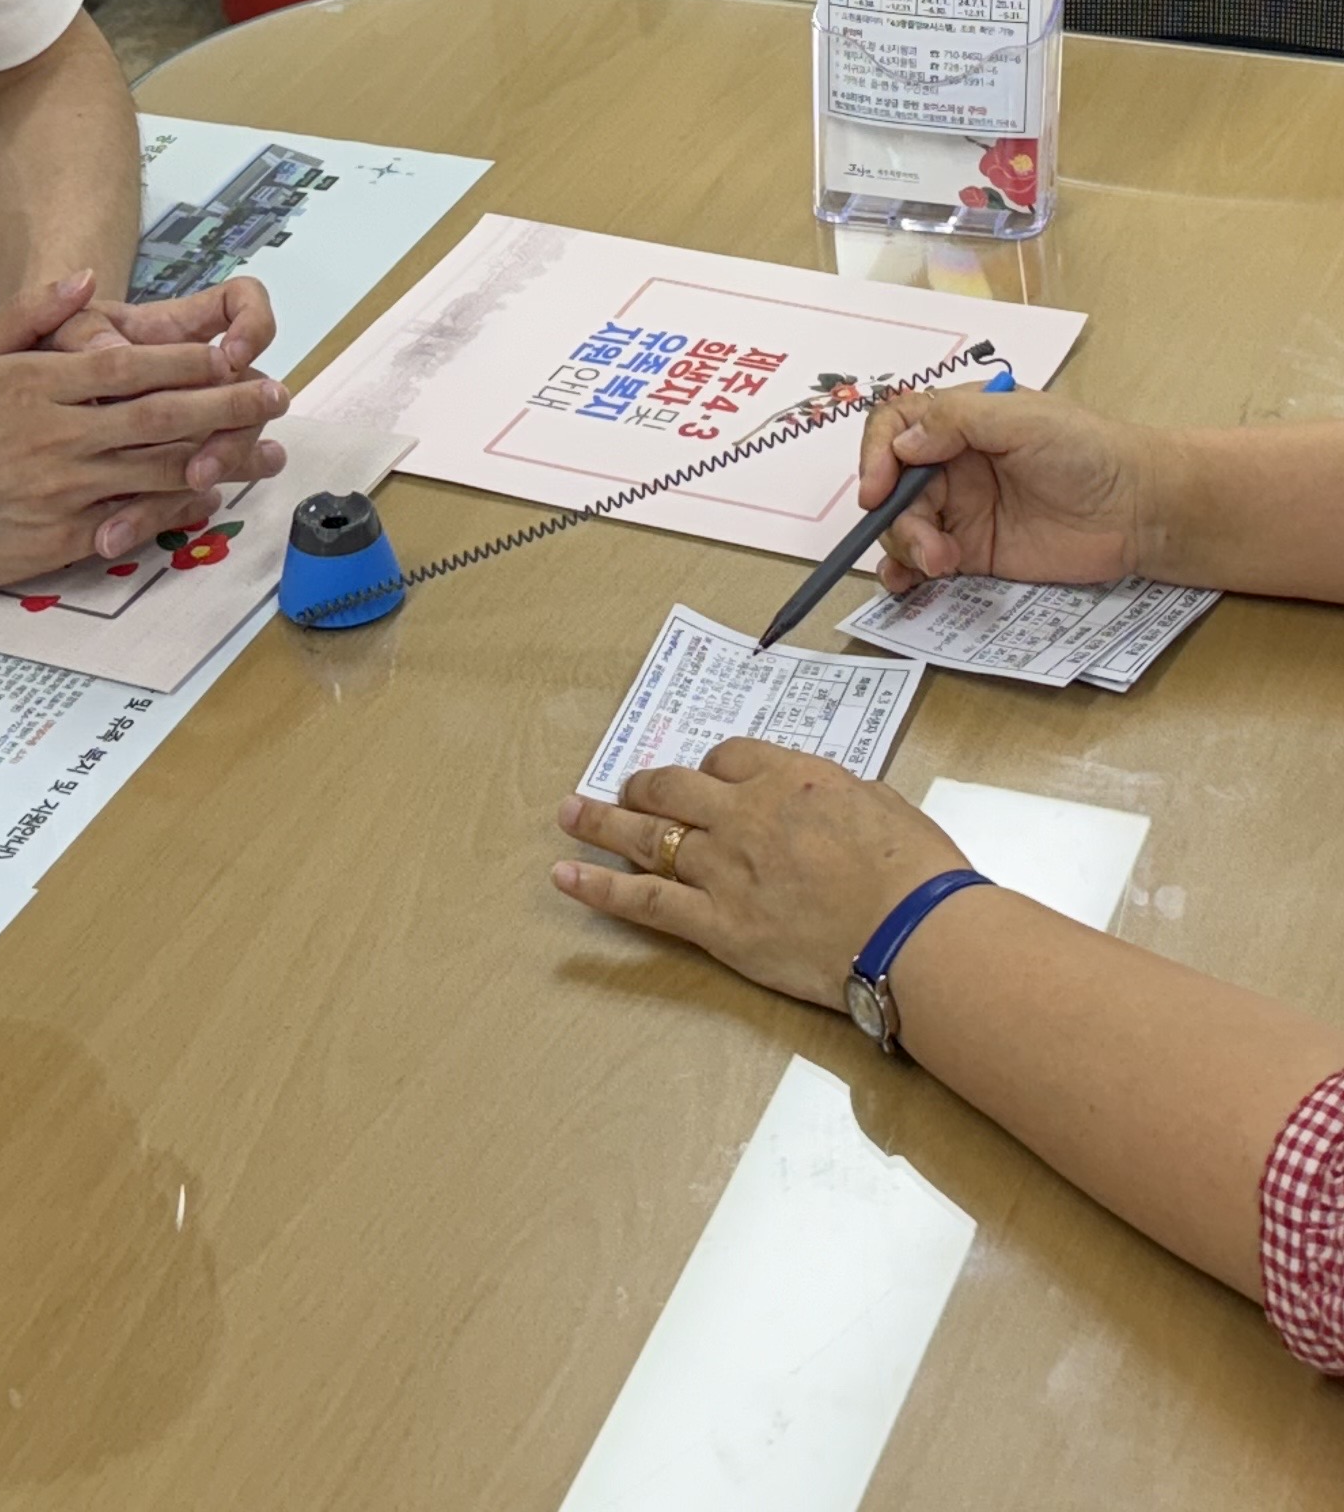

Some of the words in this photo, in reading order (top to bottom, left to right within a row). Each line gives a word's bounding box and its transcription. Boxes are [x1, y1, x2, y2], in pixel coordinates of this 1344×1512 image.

[569, 321, 642, 365] 지원
[617, 331, 687, 374] 유족
[648, 339, 736, 405] 희생자
[718, 347, 787, 396] 제주
[526, 364, 600, 411] 안내
[575, 375, 648, 421] 복지
[623, 405, 680, 431] 및
[123, 697, 153, 712] 및
[96, 715, 134, 742] 유족
[863, 707, 885, 734] 희생자
[66, 746, 107, 775] 복지
[847, 737, 872, 764] 보상금
[47, 779, 79, 795] 및
